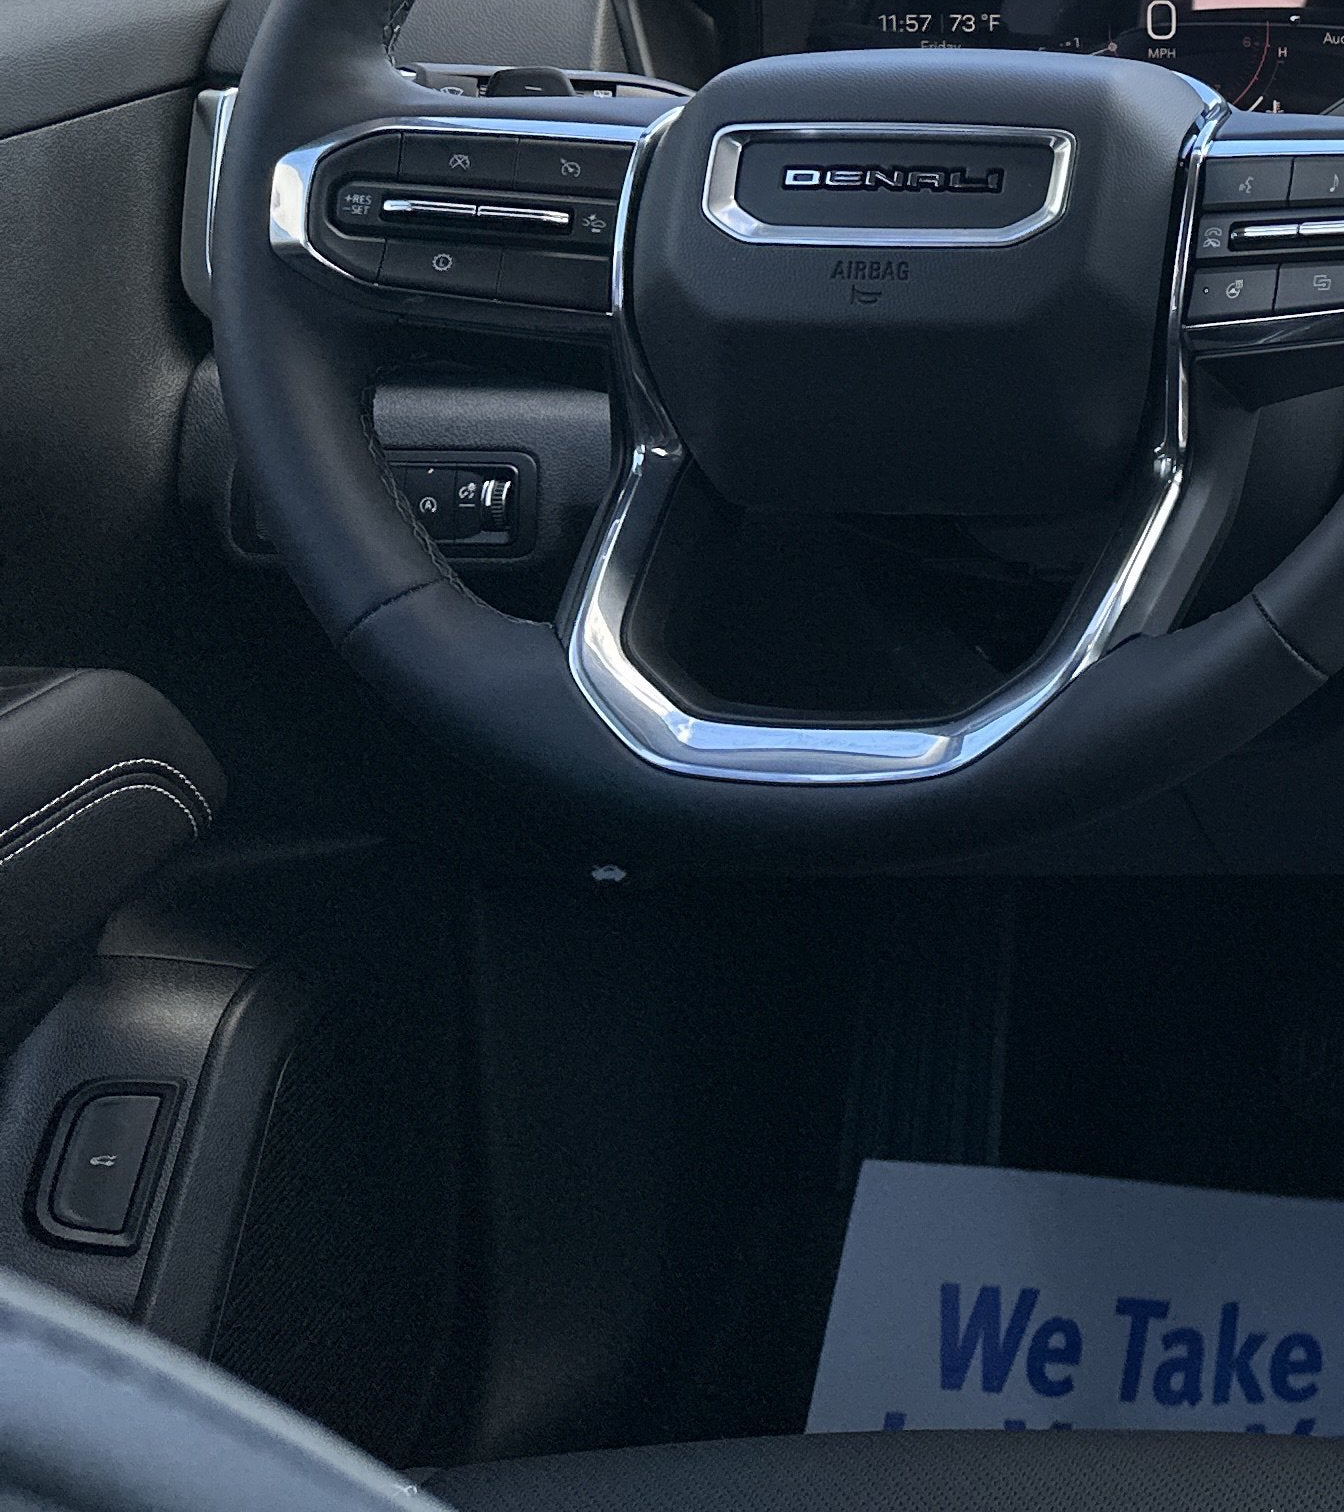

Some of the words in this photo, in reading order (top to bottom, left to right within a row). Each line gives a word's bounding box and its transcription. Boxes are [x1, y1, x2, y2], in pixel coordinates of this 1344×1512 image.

[878, 14, 932, 33] 11:57
[949, 14, 976, 33] 73
[981, 13, 1001, 32] °F
[1146, 0, 1177, 40] 0
[920, 40, 962, 50] Friday
[1147, 48, 1177, 59] MPH
[1278, 46, 1288, 58] H
[784, 168, 1001, 190] DENALI
[829, 260, 910, 281] AIRBAG
[938, 1282, 1084, 1399] We
[1115, 1296, 1324, 1407] Take
